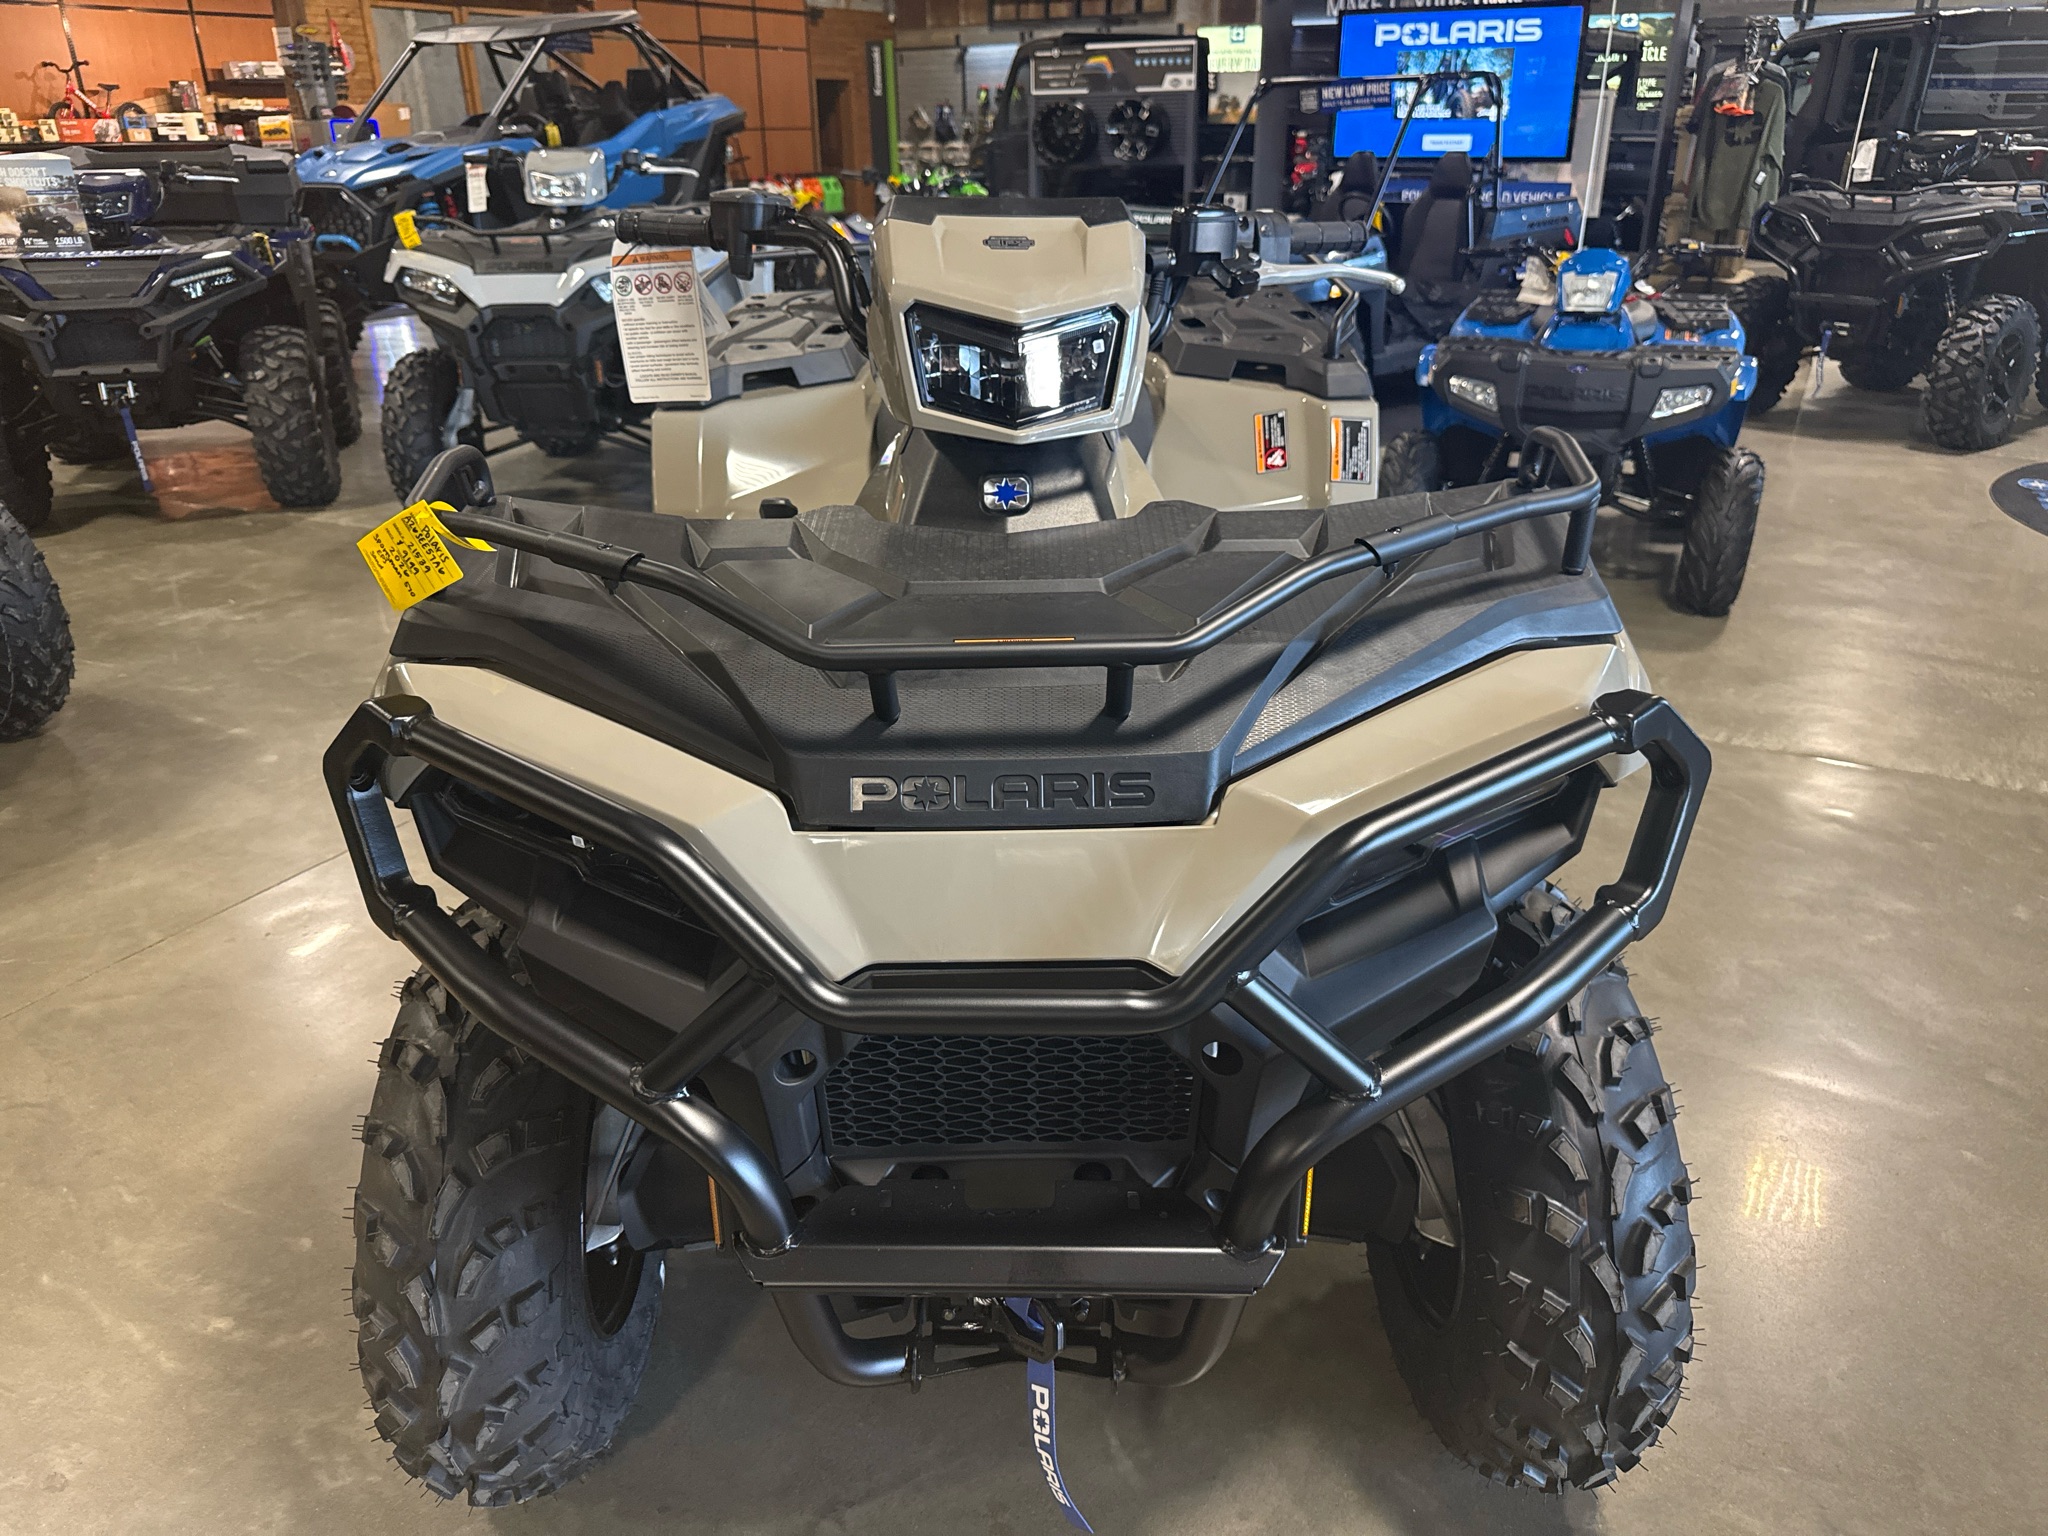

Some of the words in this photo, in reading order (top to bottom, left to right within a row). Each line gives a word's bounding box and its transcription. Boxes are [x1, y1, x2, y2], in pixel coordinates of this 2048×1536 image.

[1374, 18, 1543, 47] POLARIS
[1321, 86, 1343, 100] NEW
[1344, 83, 1366, 98] LOW
[1366, 80, 1390, 95] PRICE
[640, 253, 670, 263] WARNING
[421, 525, 449, 562] Polaris
[390, 547, 409, 577] 2026
[849, 774, 1156, 813] POLARIS
[1031, 1383, 1071, 1508] POLARIS
